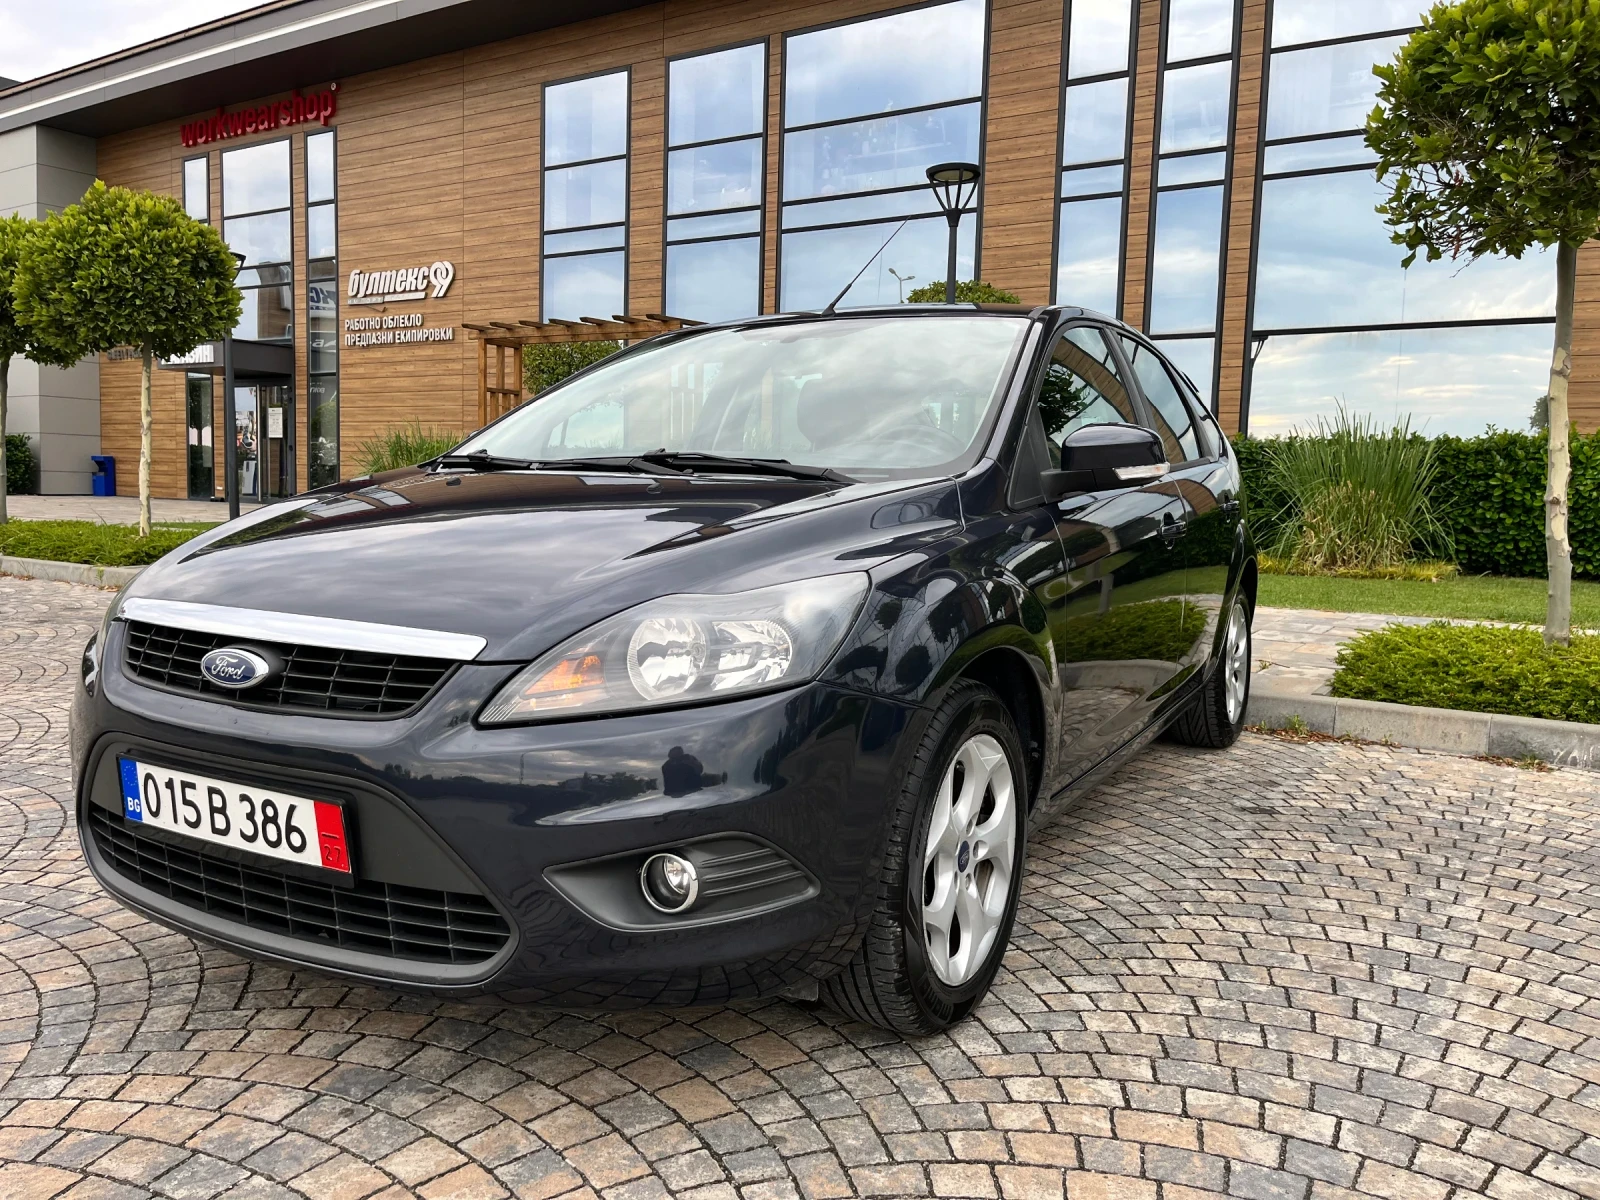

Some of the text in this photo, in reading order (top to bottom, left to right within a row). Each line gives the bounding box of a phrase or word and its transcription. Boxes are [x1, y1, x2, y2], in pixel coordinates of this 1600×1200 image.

[180, 90, 335, 147] workwearshop
[344, 313, 423, 331] РАБОТНО ОБЛЕКЛО
[344, 331, 394, 347] ПРЕДПАЗНИ
[395, 327, 454, 343] ЕКИПИРОВКИ
[211, 655, 246, 680] Ford
[127, 797, 141, 812] BG
[324, 843, 342, 862] 27
